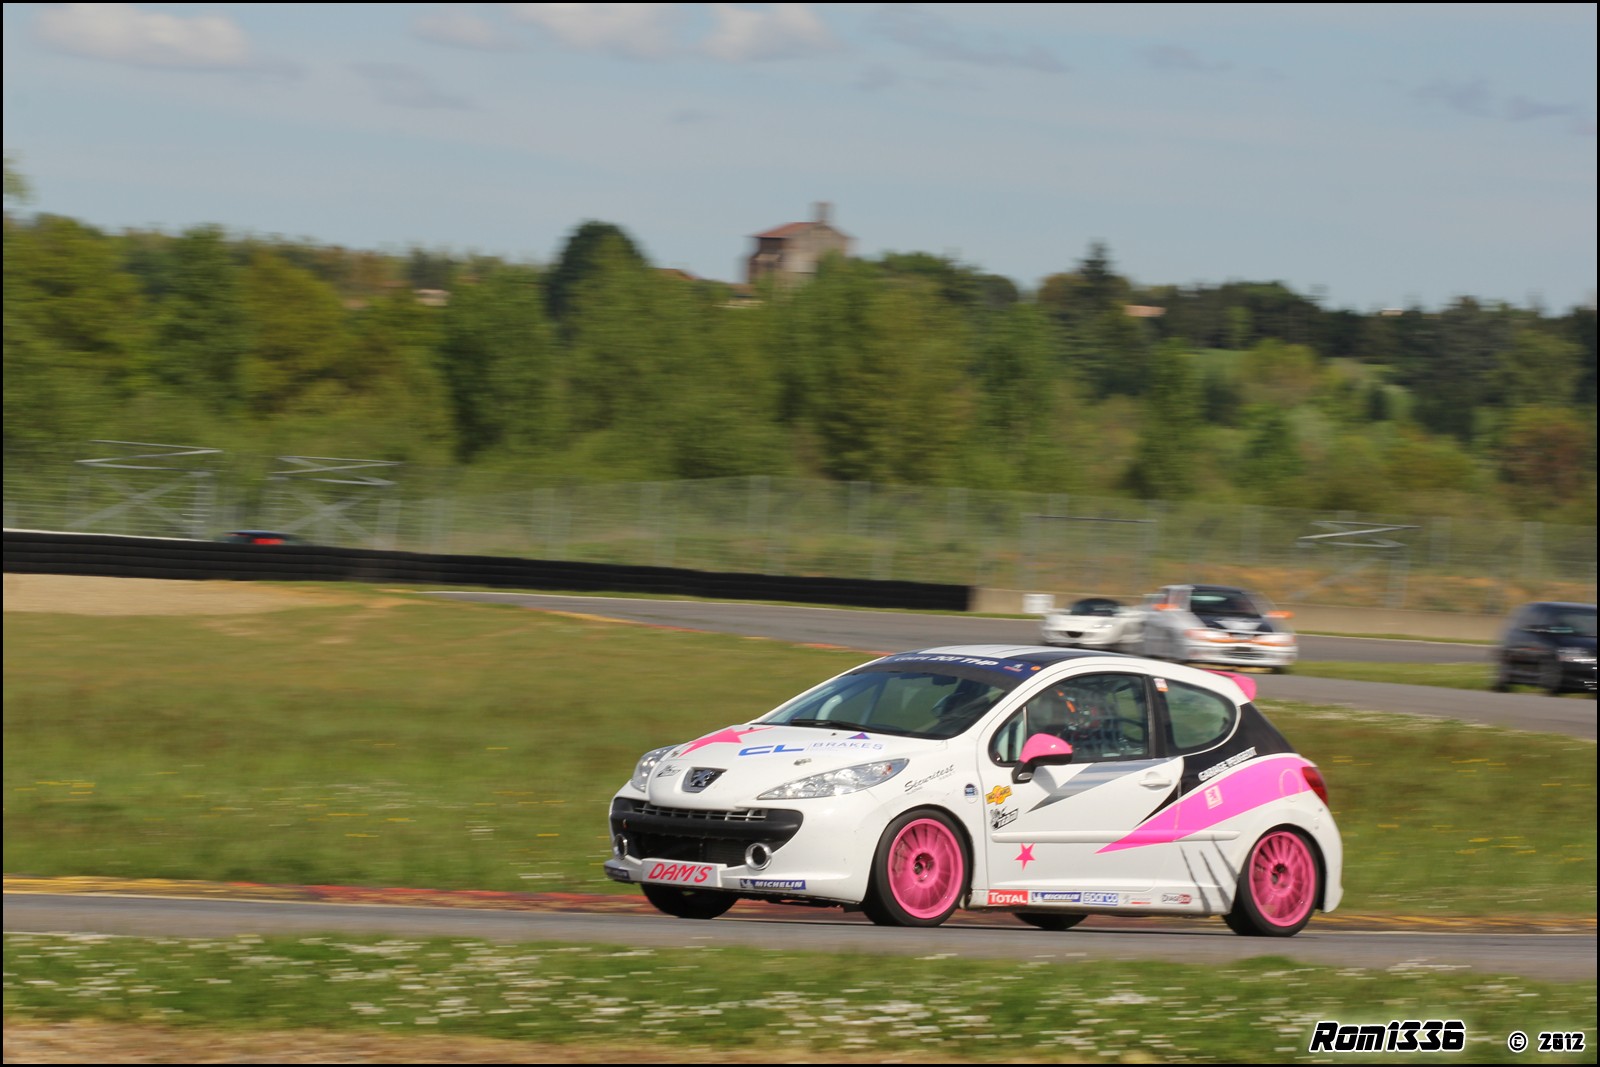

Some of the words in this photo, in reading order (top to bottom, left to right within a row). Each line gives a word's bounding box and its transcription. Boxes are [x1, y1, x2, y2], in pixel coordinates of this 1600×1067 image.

[960, 657, 1000, 666] THP
[738, 744, 805, 757] CL
[812, 741, 884, 750] BRAKES
[648, 863, 713, 883] DAM'S
[989, 892, 1027, 904] TOTAL
